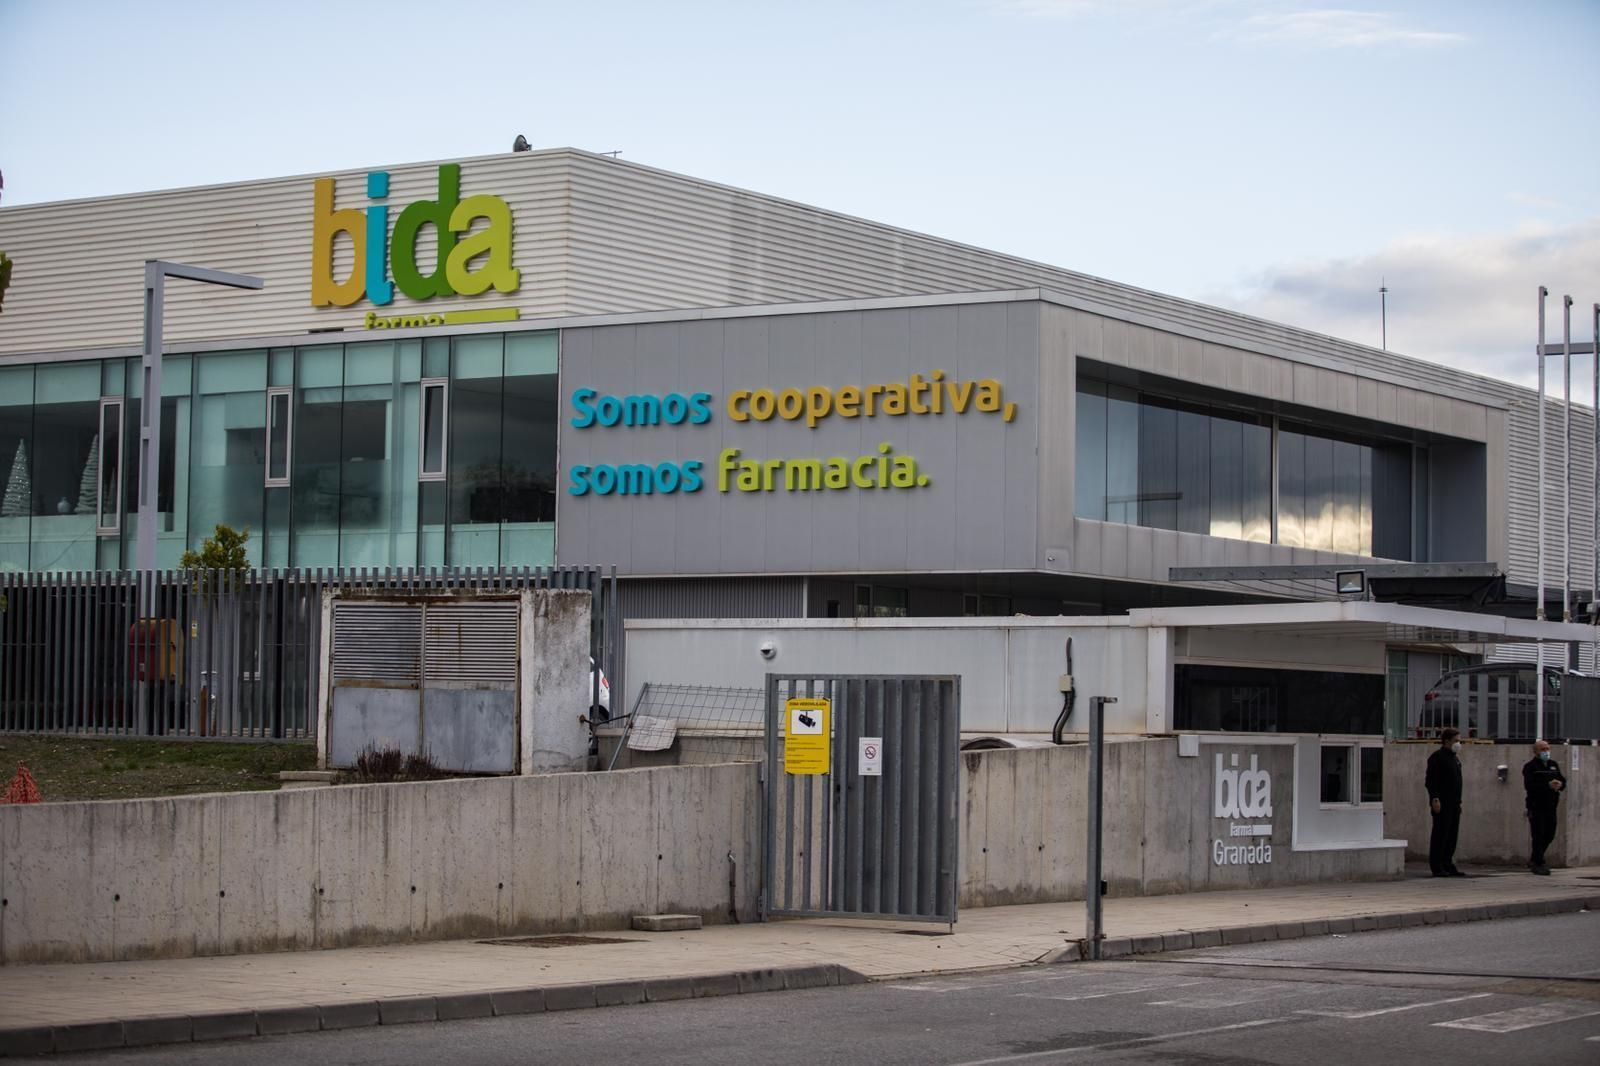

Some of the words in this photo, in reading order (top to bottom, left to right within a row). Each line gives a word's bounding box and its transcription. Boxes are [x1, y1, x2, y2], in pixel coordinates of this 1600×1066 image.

[311, 163, 520, 306] bida
[365, 312, 444, 329] farma
[571, 388, 711, 428] Somos
[727, 369, 1017, 428] cooperativa,
[569, 460, 703, 497] somos
[718, 443, 930, 492] farmacia.
[1215, 753, 1272, 818] bida
[1213, 839, 1272, 865] Granada
